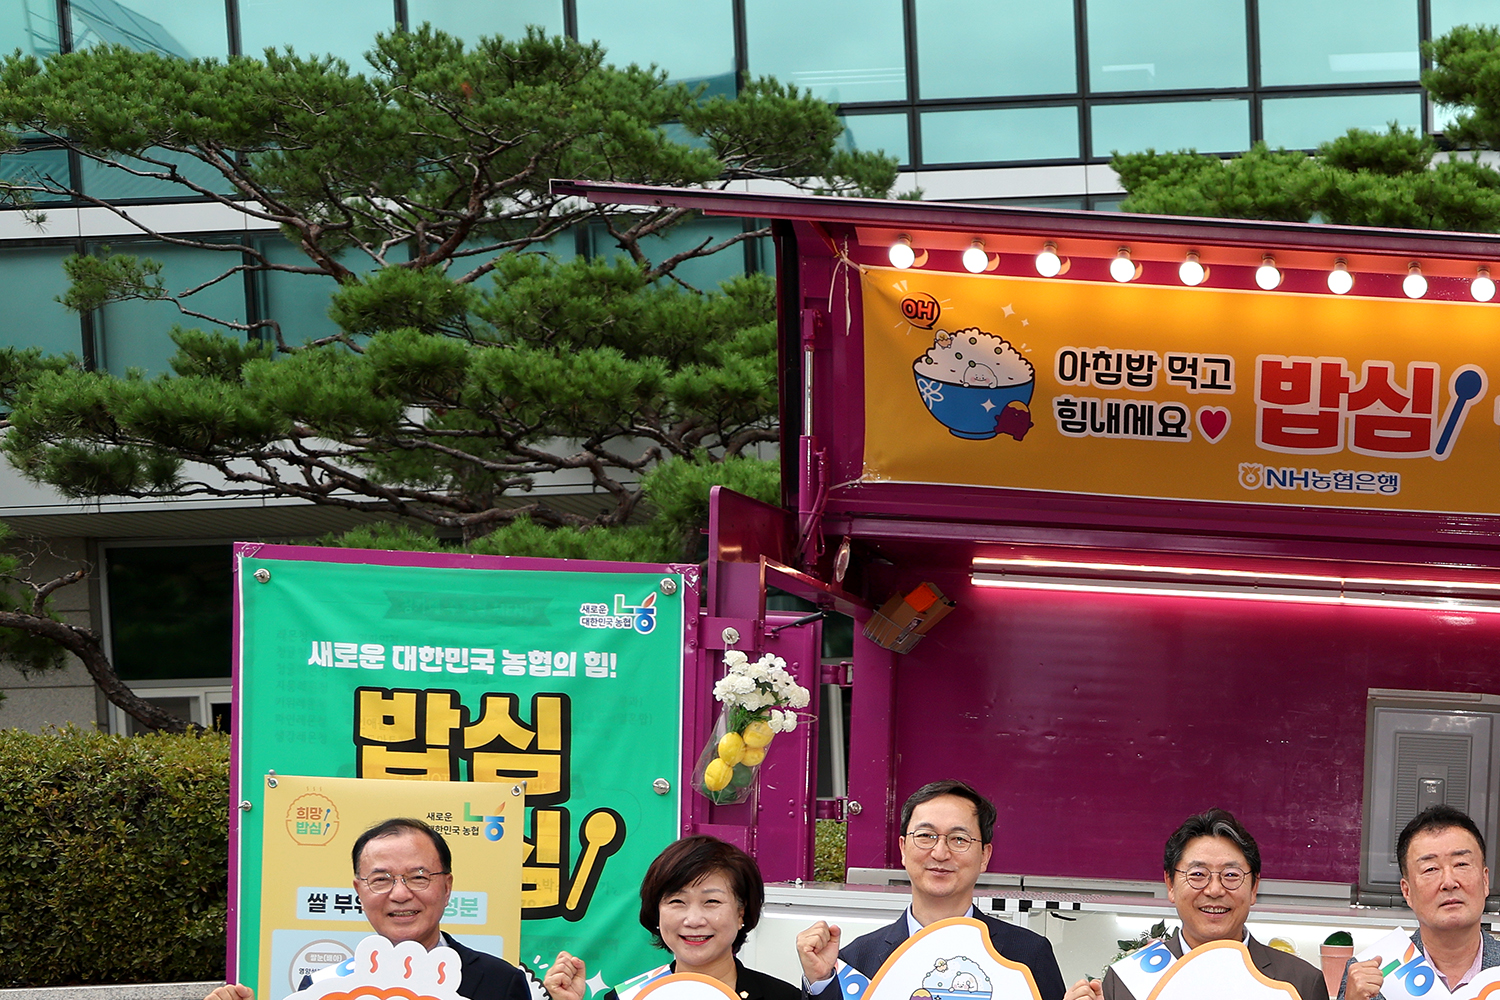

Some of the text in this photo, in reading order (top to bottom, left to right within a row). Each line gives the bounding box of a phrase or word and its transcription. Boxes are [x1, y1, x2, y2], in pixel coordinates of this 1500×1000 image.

[901, 299, 934, 320] OH
[1057, 350, 1232, 391] 아침밥 먹고
[1261, 360, 1435, 453] 밥심
[1056, 398, 1188, 438] 힘내세요
[1266, 469, 1399, 494] NH농협은행
[581, 604, 607, 614] 새로운
[581, 616, 631, 629] 대한민국 농협
[308, 641, 385, 670] 새로운
[392, 645, 495, 675] 대한민국
[501, 650, 577, 677] 농협의
[584, 652, 618, 678] 힘!
[296, 806, 323, 820] 희망
[426, 812, 453, 822] 새로운
[296, 821, 322, 835] 밥심
[462, 826, 480, 836] 농협
[307, 893, 328, 913] 쌀
